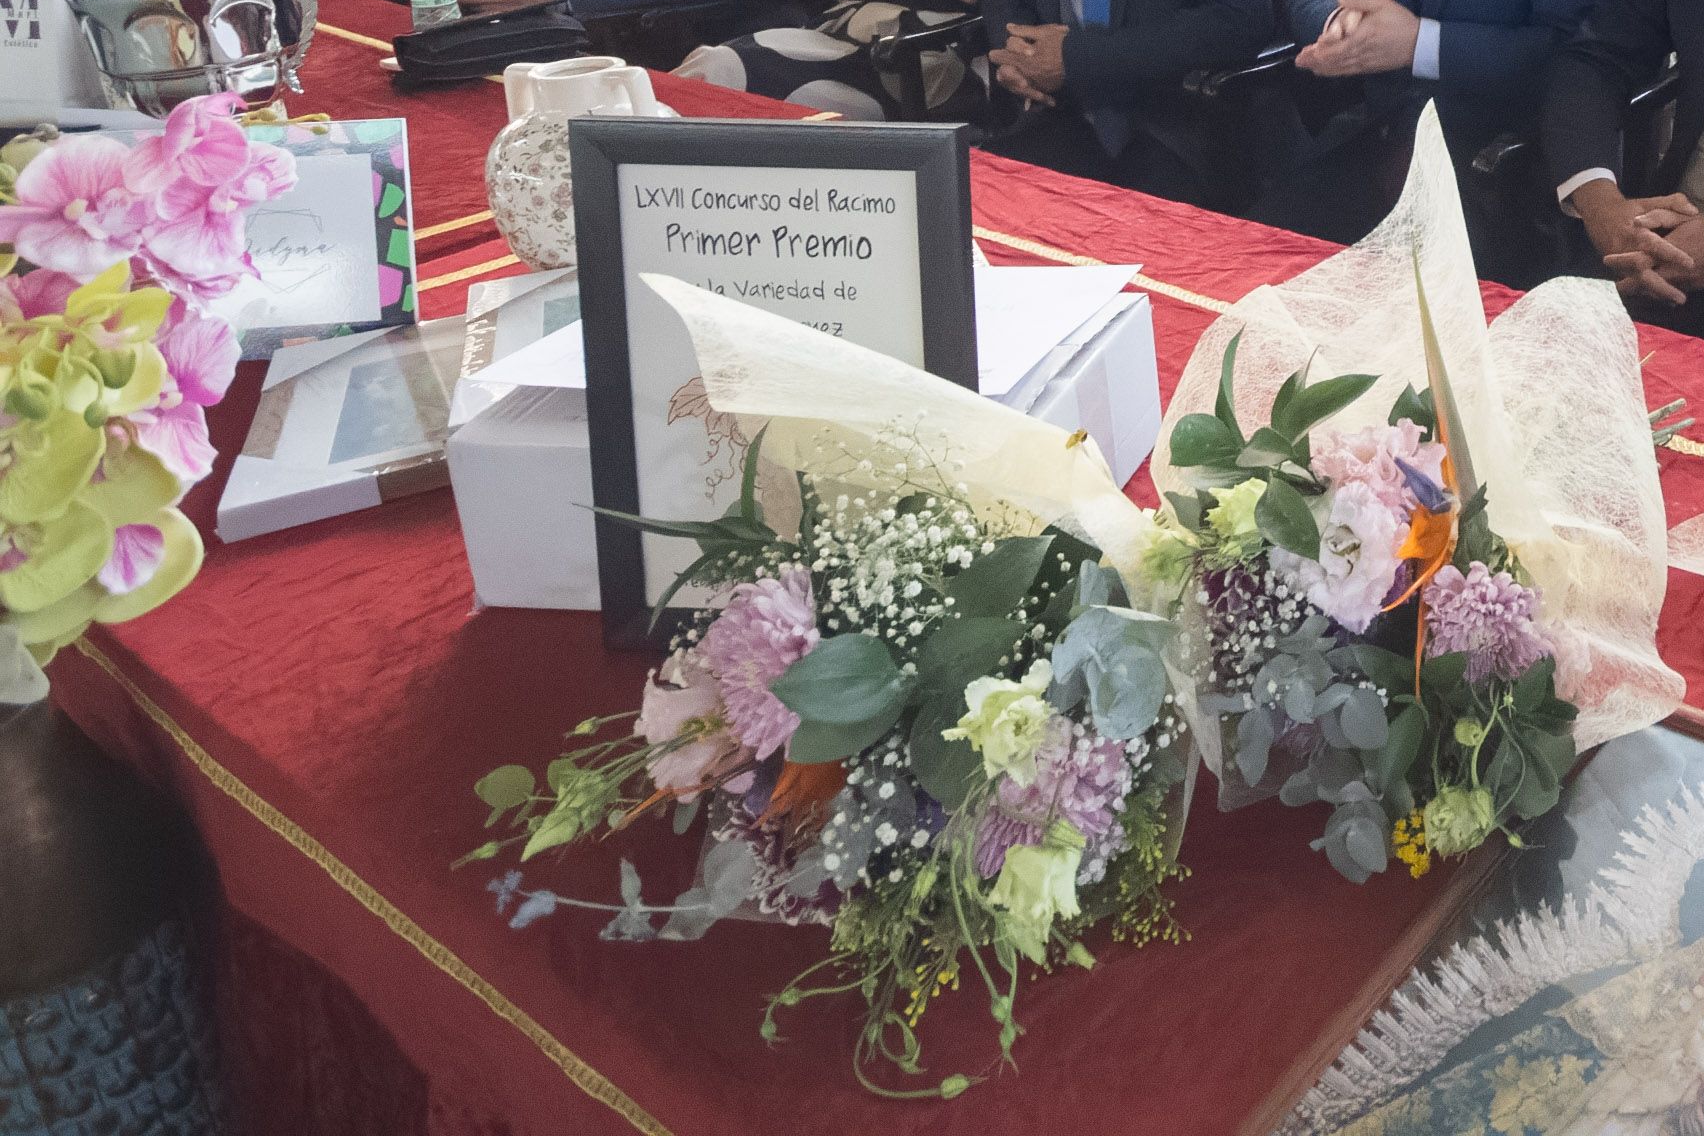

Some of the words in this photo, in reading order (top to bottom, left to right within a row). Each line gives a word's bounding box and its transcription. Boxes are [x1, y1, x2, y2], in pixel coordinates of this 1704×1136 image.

[635, 185, 684, 209] LXVII
[692, 187, 781, 212] Concurso
[788, 187, 820, 212] del
[827, 189, 896, 214] Racimo
[666, 223, 761, 257] Primer
[772, 225, 872, 260] Premio
[733, 280, 825, 300] Variedad
[833, 281, 858, 301] de
